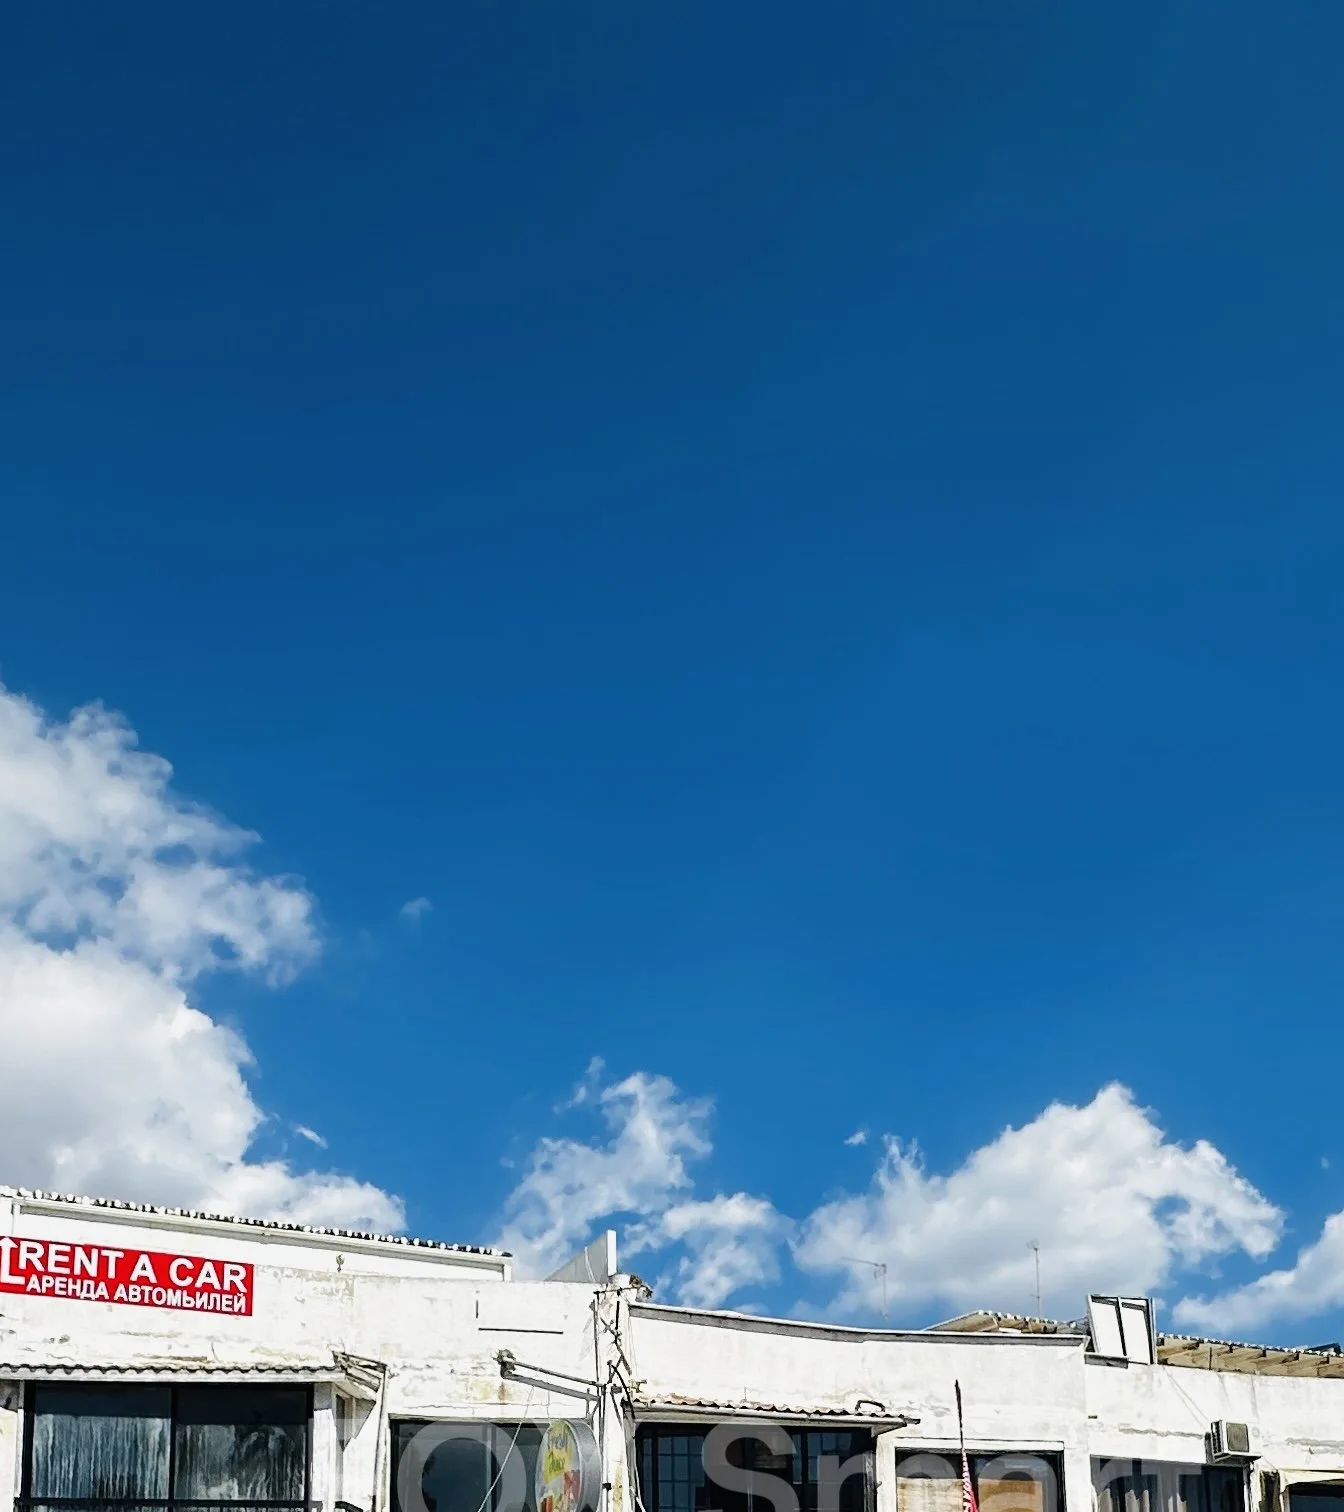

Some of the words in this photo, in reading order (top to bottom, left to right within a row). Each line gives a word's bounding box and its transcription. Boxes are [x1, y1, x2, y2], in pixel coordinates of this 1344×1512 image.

[17, 1241, 124, 1280] RENT
[130, 1254, 157, 1283] A
[168, 1257, 248, 1293] CAR
[25, 1274, 109, 1301] АРЕНДА
